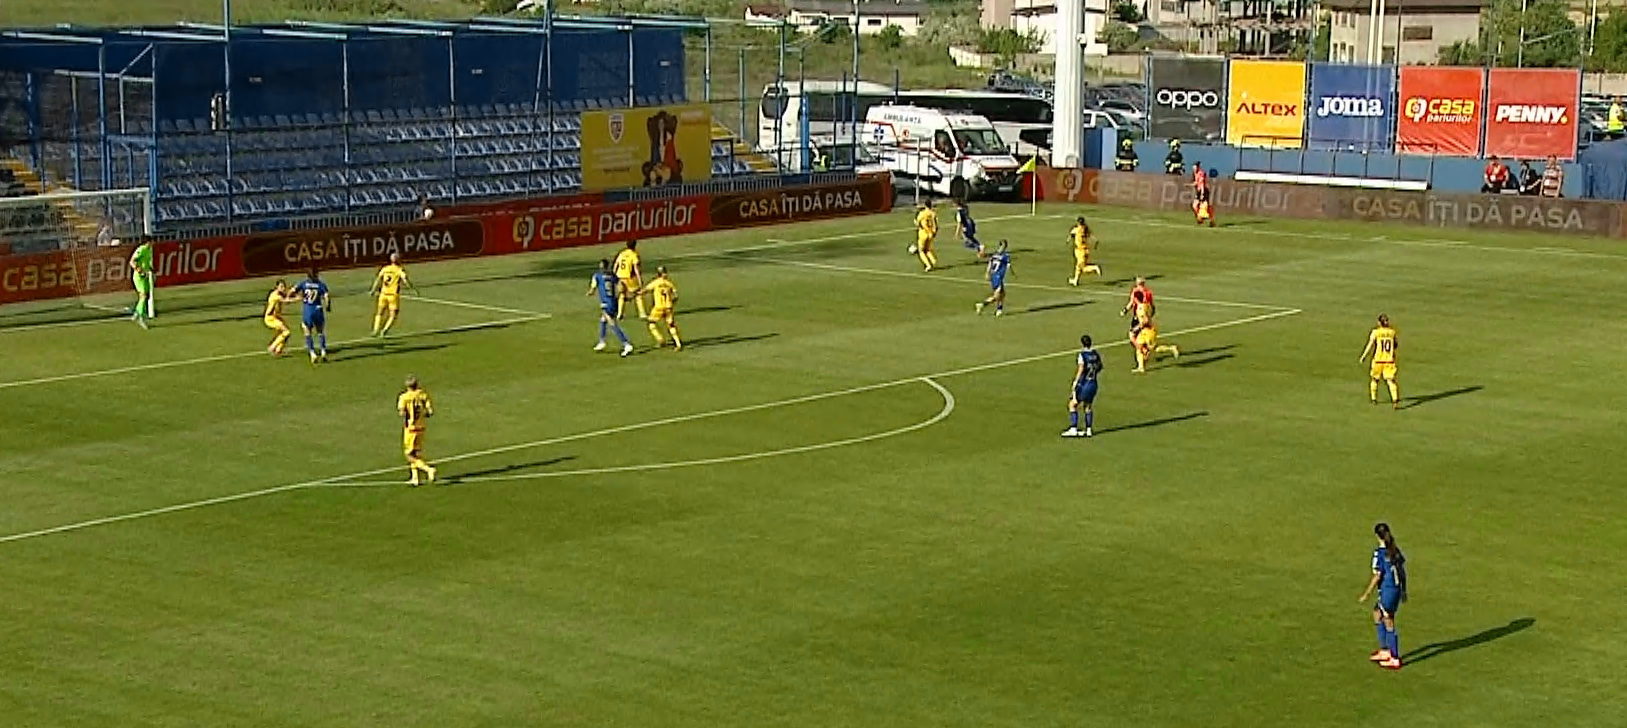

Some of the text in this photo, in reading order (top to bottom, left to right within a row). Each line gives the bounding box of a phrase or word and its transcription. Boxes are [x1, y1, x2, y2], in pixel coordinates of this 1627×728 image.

[1157, 90, 1218, 110] oppo
[1429, 98, 1475, 114] casa
[1427, 113, 1472, 124] pariurilor
[1496, 105, 1567, 125] PENNY.
[739, 198, 778, 218] CASA
[802, 190, 822, 213] DĂ
[826, 191, 862, 210] PASA
[1089, 176, 1292, 211] casa paiurilor
[540, 215, 592, 240] casa
[598, 201, 697, 240] pariurilor
[1353, 195, 1420, 219] CASA
[1466, 198, 1502, 224] DĂ
[1511, 204, 1583, 229] PASA
[284, 241, 338, 262] CASA
[373, 231, 400, 256] DĂ
[404, 230, 455, 252] PASA
[3, 262, 76, 292] casa
[1380, 338, 1391, 353] 10
